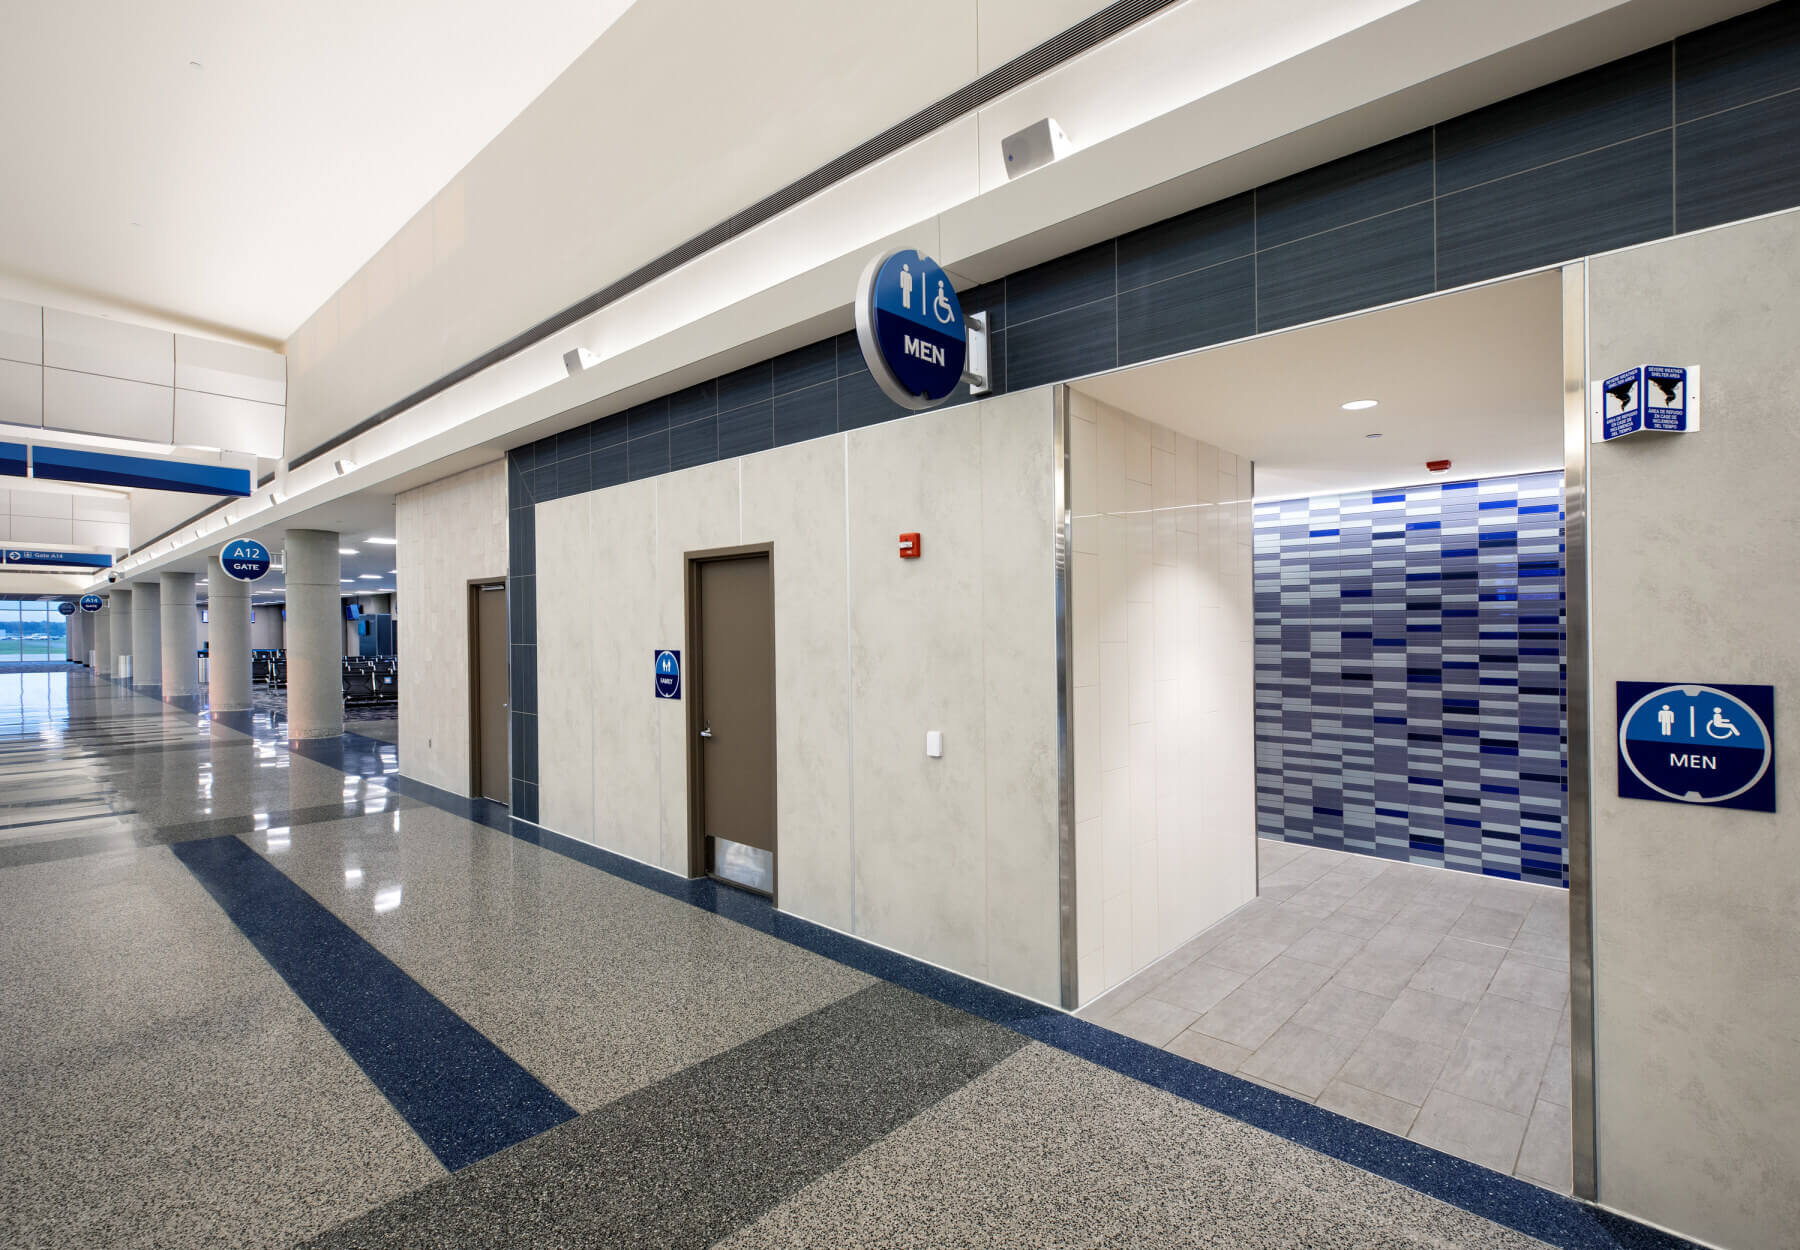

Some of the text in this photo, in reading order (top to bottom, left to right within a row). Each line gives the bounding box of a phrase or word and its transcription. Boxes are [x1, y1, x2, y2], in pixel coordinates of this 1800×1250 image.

[904, 335, 945, 367] MEN
[233, 547, 260, 559] A12
[233, 563, 260, 571] GATE
[1669, 753, 1717, 770] MEN
